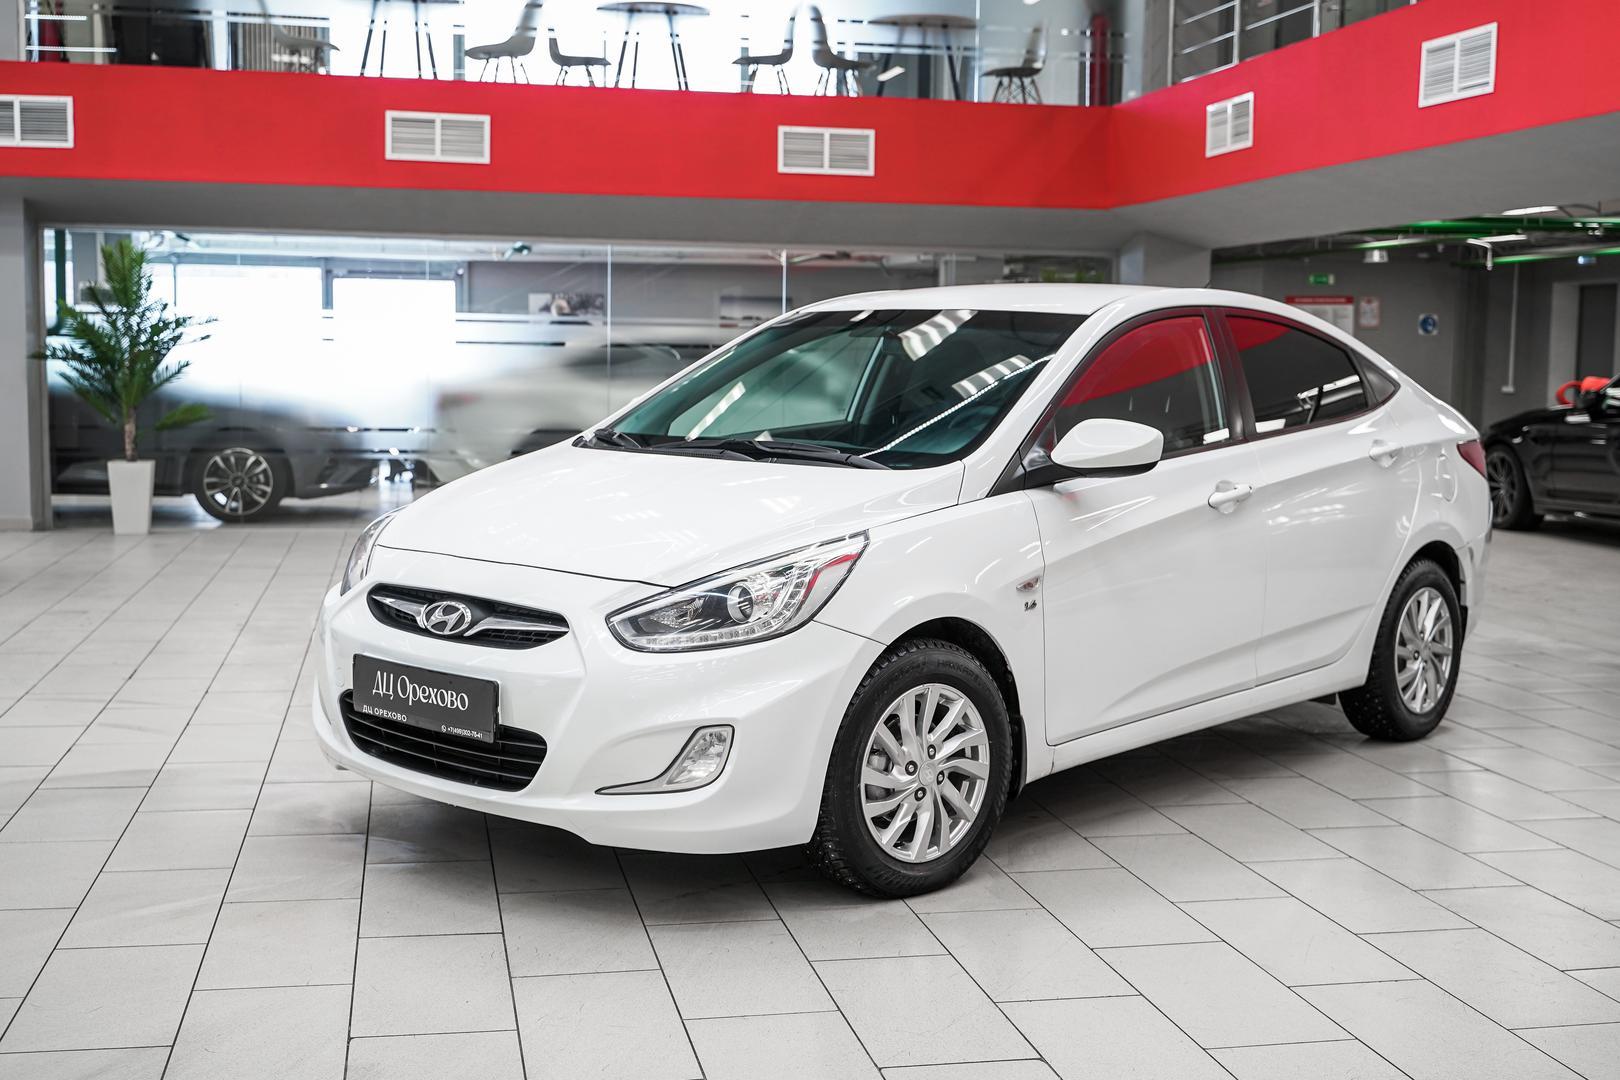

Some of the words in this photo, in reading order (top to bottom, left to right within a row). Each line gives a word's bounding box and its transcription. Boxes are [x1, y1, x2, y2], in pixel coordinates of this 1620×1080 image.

[372, 670, 394, 700] ДЦ
[397, 675, 469, 711] Орехово
[362, 704, 373, 715] ДЦ
[374, 707, 407, 722] ОРЕХОВО
